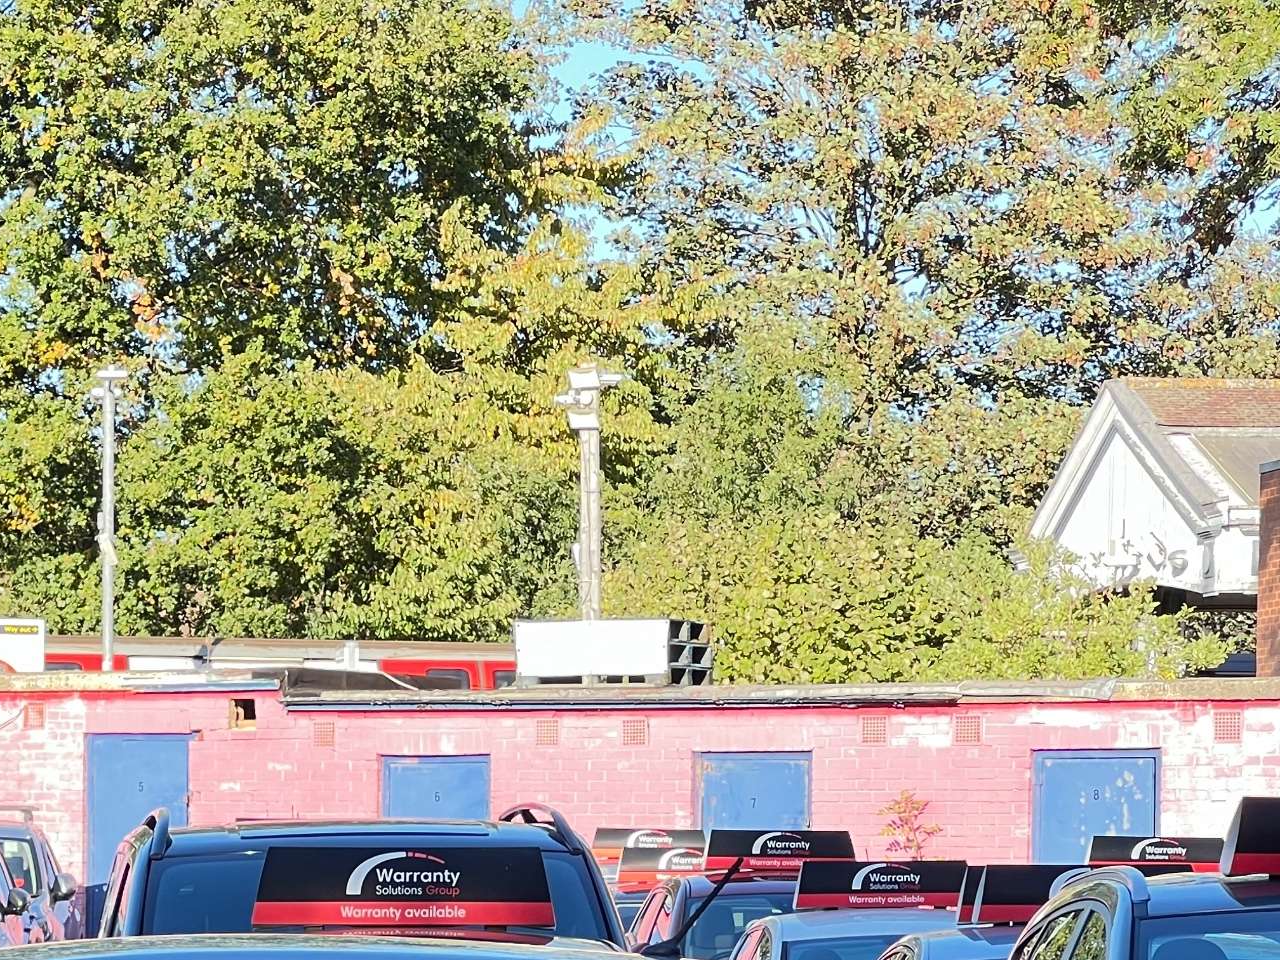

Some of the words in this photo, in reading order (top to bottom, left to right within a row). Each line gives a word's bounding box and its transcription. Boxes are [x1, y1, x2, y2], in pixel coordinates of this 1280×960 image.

[434, 791, 441, 802] 6
[1093, 789, 1100, 801] 8
[750, 797, 757, 809] 7
[639, 835, 673, 845] Warranty
[767, 840, 810, 850] Warranty
[1145, 846, 1187, 857] Warranty
[671, 856, 704, 865] Warran
[749, 859, 780, 867] Warranty
[376, 868, 460, 887] Warranty
[869, 873, 920, 884] Warranty
[375, 885, 423, 896] Solutions
[425, 885, 460, 897] Group
[848, 895, 886, 905] Warranty
[887, 895, 925, 903] available
[340, 906, 401, 921] Warranty
[404, 906, 466, 918] available
